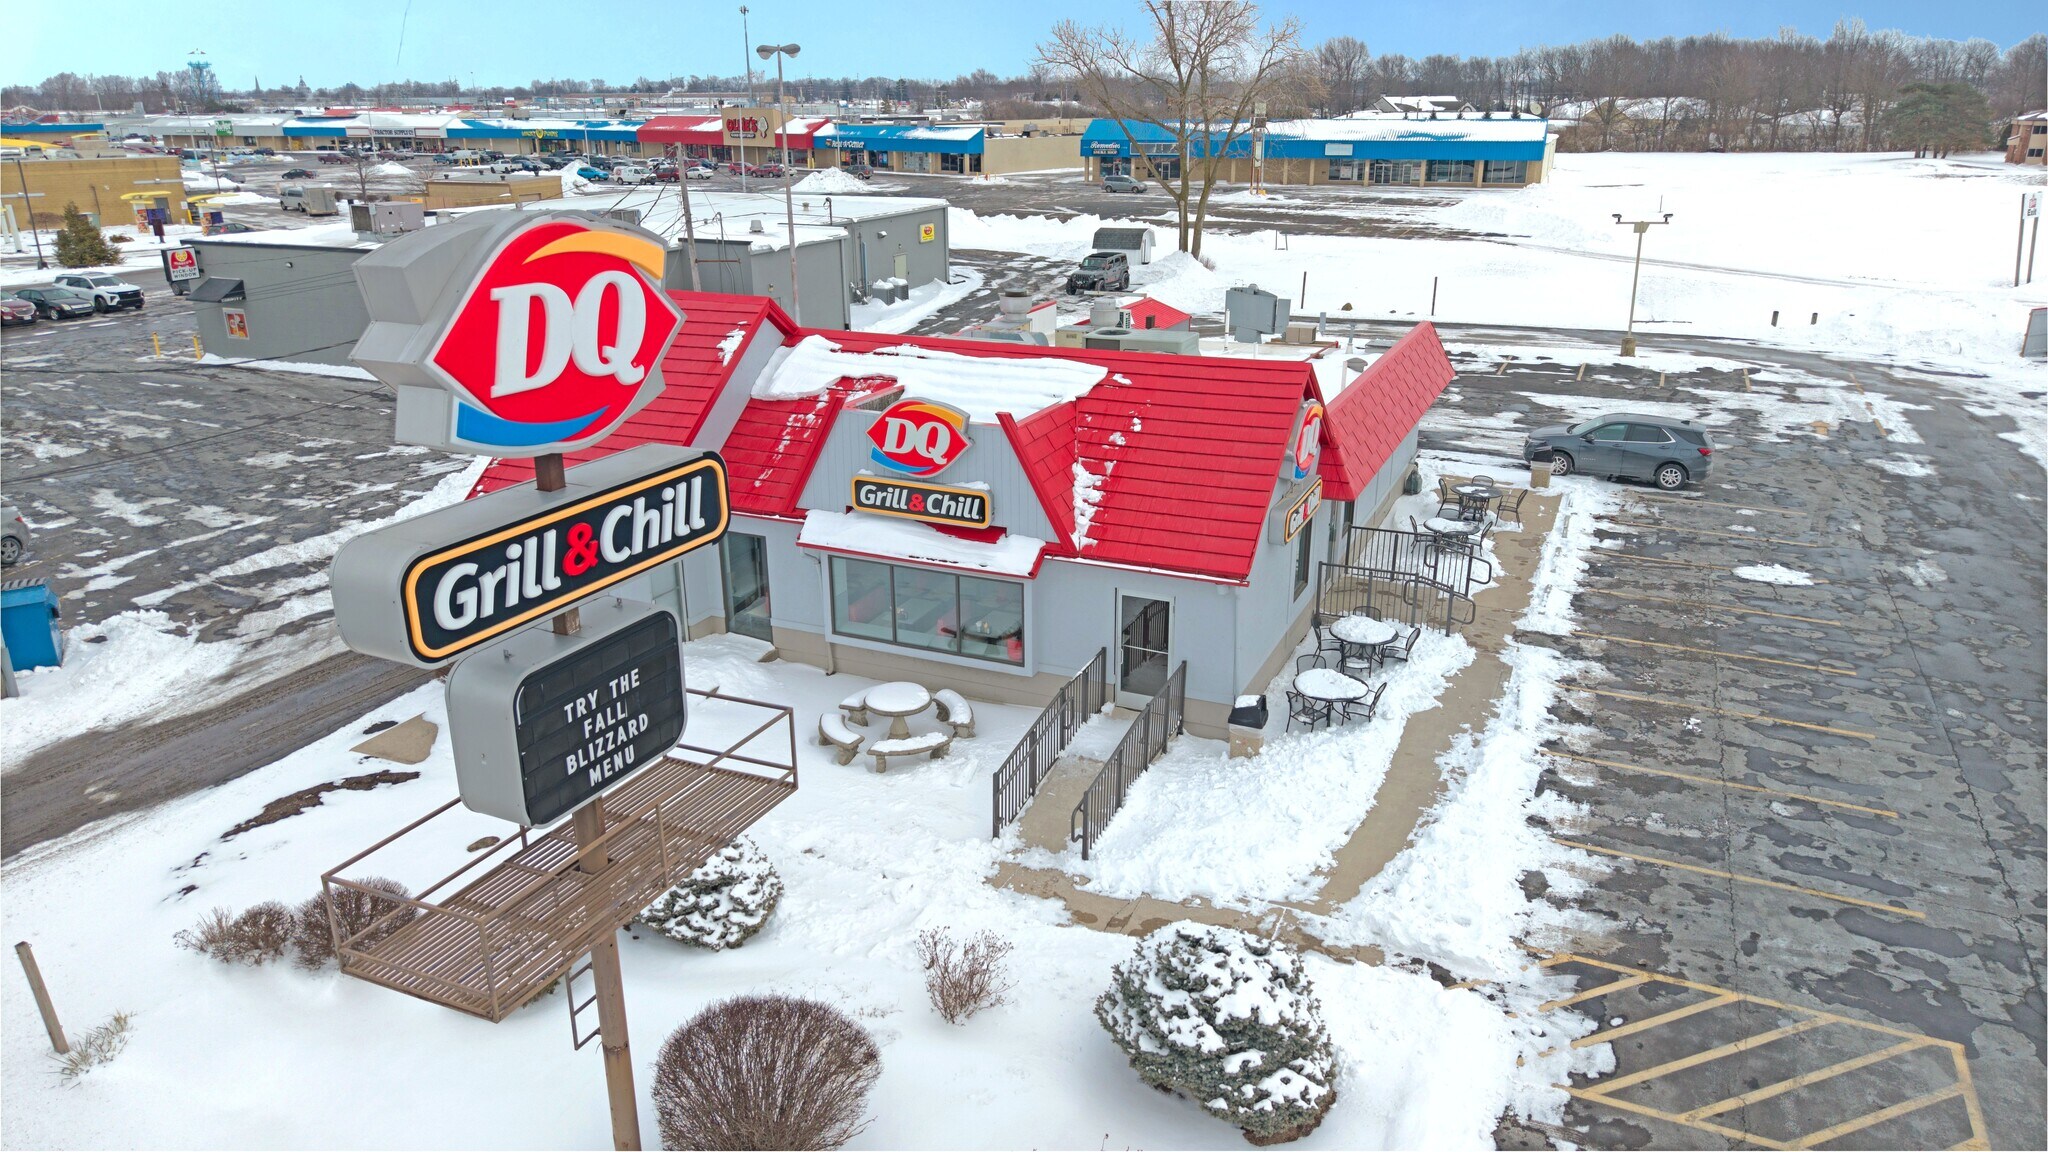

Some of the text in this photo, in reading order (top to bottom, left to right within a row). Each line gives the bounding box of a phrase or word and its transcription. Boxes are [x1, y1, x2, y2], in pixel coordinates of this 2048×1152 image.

[490, 270, 646, 399] DQ
[882, 416, 951, 465] DQ
[564, 668, 640, 723] TRY THE
[583, 701, 627, 740] FALL
[566, 713, 649, 776] BLIZZARD
[588, 744, 636, 787] MENU
